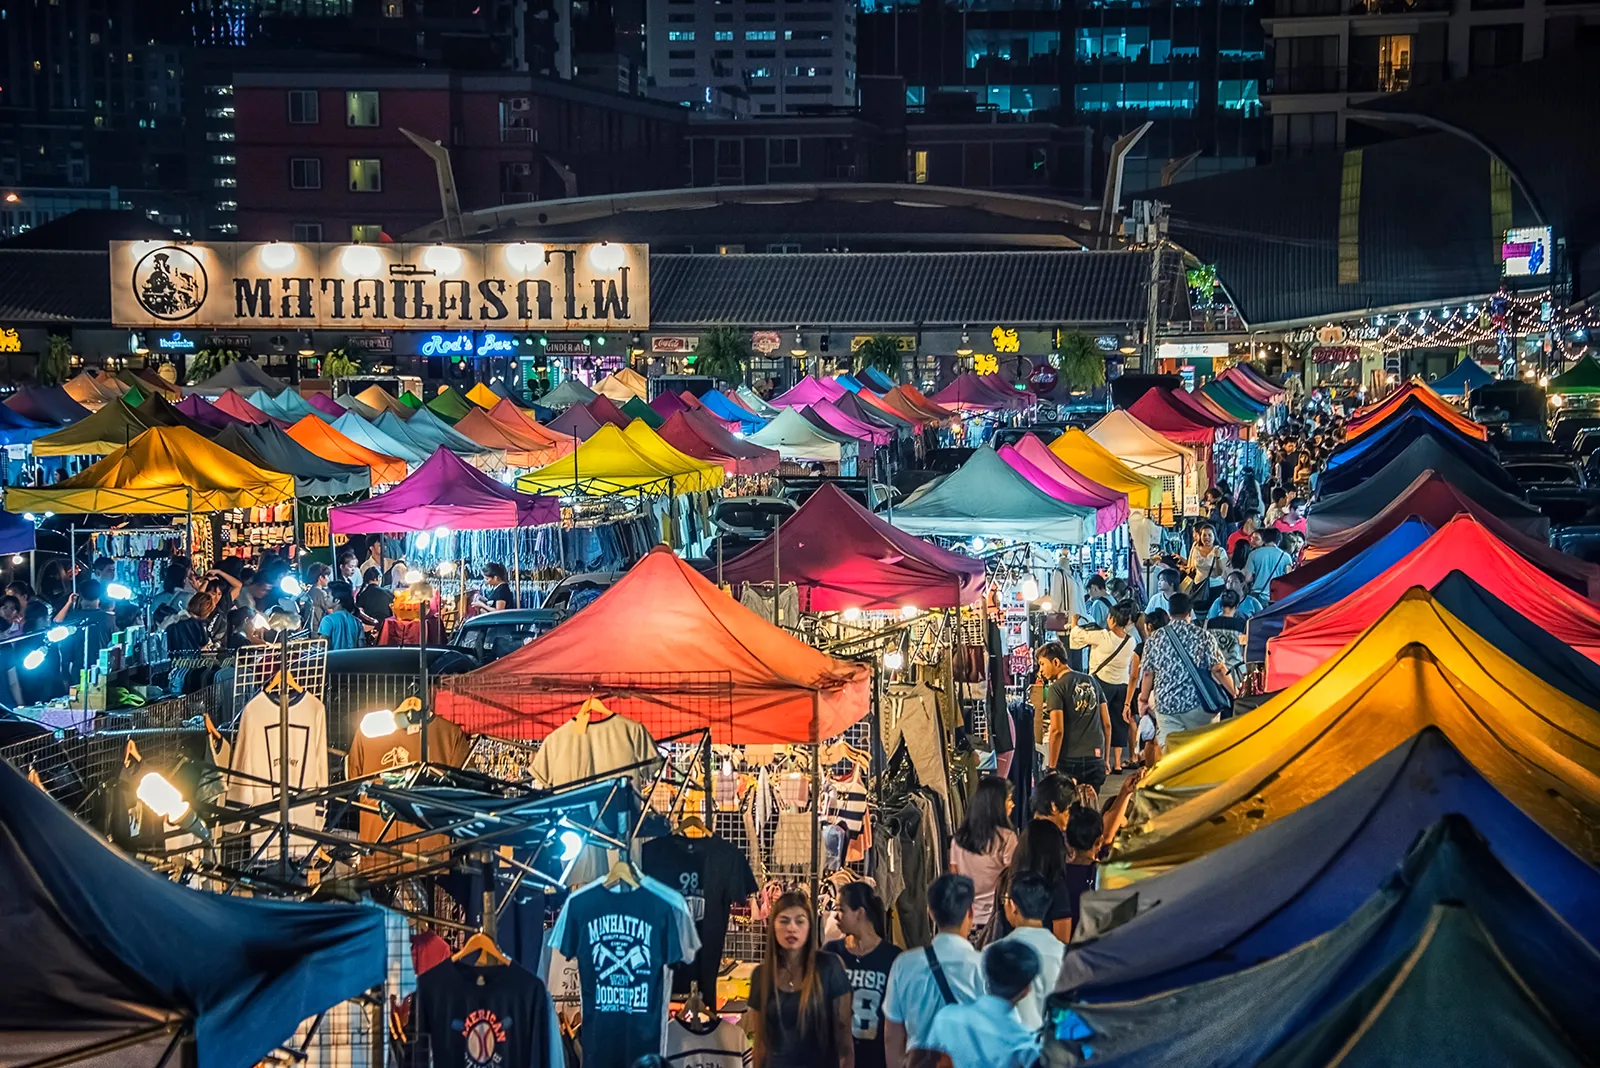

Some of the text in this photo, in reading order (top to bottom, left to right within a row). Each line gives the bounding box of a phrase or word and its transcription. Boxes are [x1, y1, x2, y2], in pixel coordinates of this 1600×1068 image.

[232, 249, 632, 321] ตลาดนัดรถไฟ
[422, 333, 512, 356] Rod's Bar
[679, 872, 699, 890] 98
[852, 988, 881, 1039] 8
